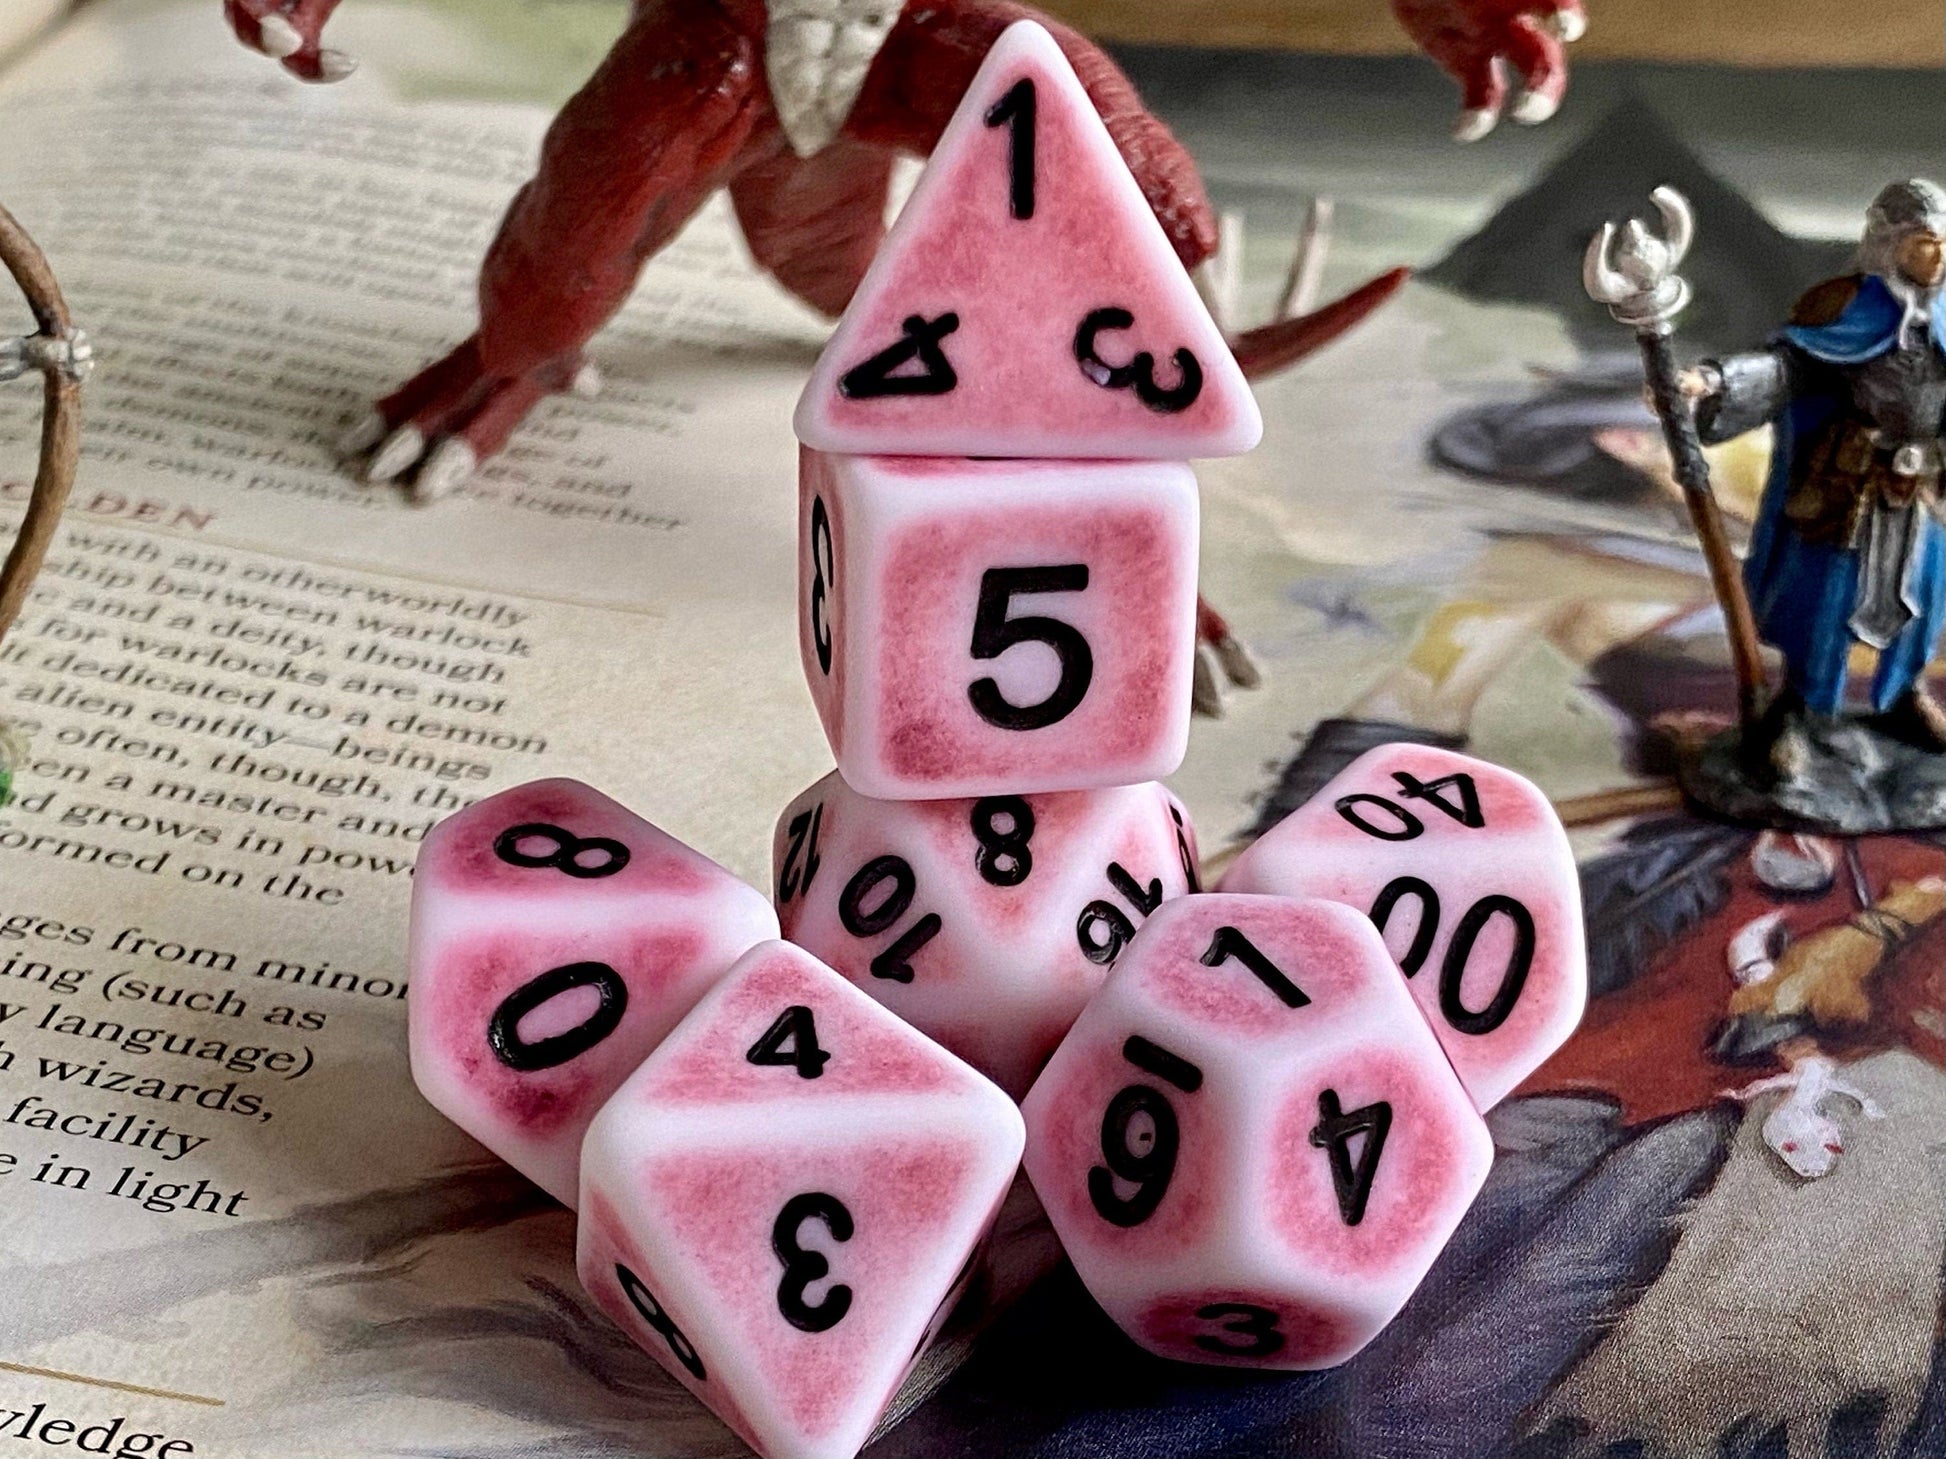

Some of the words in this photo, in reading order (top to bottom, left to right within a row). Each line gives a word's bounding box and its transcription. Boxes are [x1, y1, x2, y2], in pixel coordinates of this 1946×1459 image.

[984, 78, 1036, 220] 1
[838, 312, 959, 399] 4
[1073, 307, 1203, 414] 3
[67, 533, 160, 562] with
[172, 554, 229, 576] an
[241, 566, 531, 628] otherworldly
[149, 574, 340, 626] between
[356, 616, 532, 658] warlock
[38, 618, 108, 643] for
[120, 636, 328, 686] warlocks
[340, 676, 418, 701] are
[429, 691, 508, 716] not
[68, 598, 161, 623] and
[166, 616, 195, 630] a
[210, 620, 326, 657] deity,
[344, 642, 507, 684] though
[967, 564, 1094, 731] 5
[15, 682, 135, 719] alien
[42, 654, 276, 709] dedicated
[285, 697, 331, 721] to
[343, 709, 370, 727] a
[386, 713, 548, 754] demon
[26, 756, 91, 783] en
[104, 773, 134, 791] a
[149, 779, 327, 823] master
[337, 813, 435, 842] and
[56, 726, 190, 769] often,
[209, 753, 391, 803] though,
[411, 785, 483, 810] th
[1335, 771, 1486, 842] 40
[0, 831, 172, 875] ormed
[182, 864, 244, 888] on
[262, 873, 345, 906] the
[59, 803, 222, 845] grows
[236, 829, 284, 856] in
[493, 822, 631, 879] 8
[970, 796, 1035, 887] 8
[0, 914, 95, 947] ges
[108, 927, 238, 972] from
[838, 854, 943, 984] 10
[1370, 876, 1536, 1035] 00
[0, 951, 94, 995] ing
[103, 970, 248, 1018] (such
[262, 1006, 328, 1032] as
[1200, 926, 1312, 1009] 1
[35, 1003, 315, 1081] language)
[487, 961, 628, 1072] 0
[746, 1005, 831, 1080] 4
[3, 1096, 211, 1161] facility
[38, 1057, 275, 1123] wizards,
[30, 1153, 91, 1190] in
[106, 1166, 251, 1217] light
[1308, 1088, 1392, 1227] 4
[772, 1192, 854, 1333] 3
[616, 1263, 707, 1382] 8
[1195, 1302, 1284, 1356] 3
